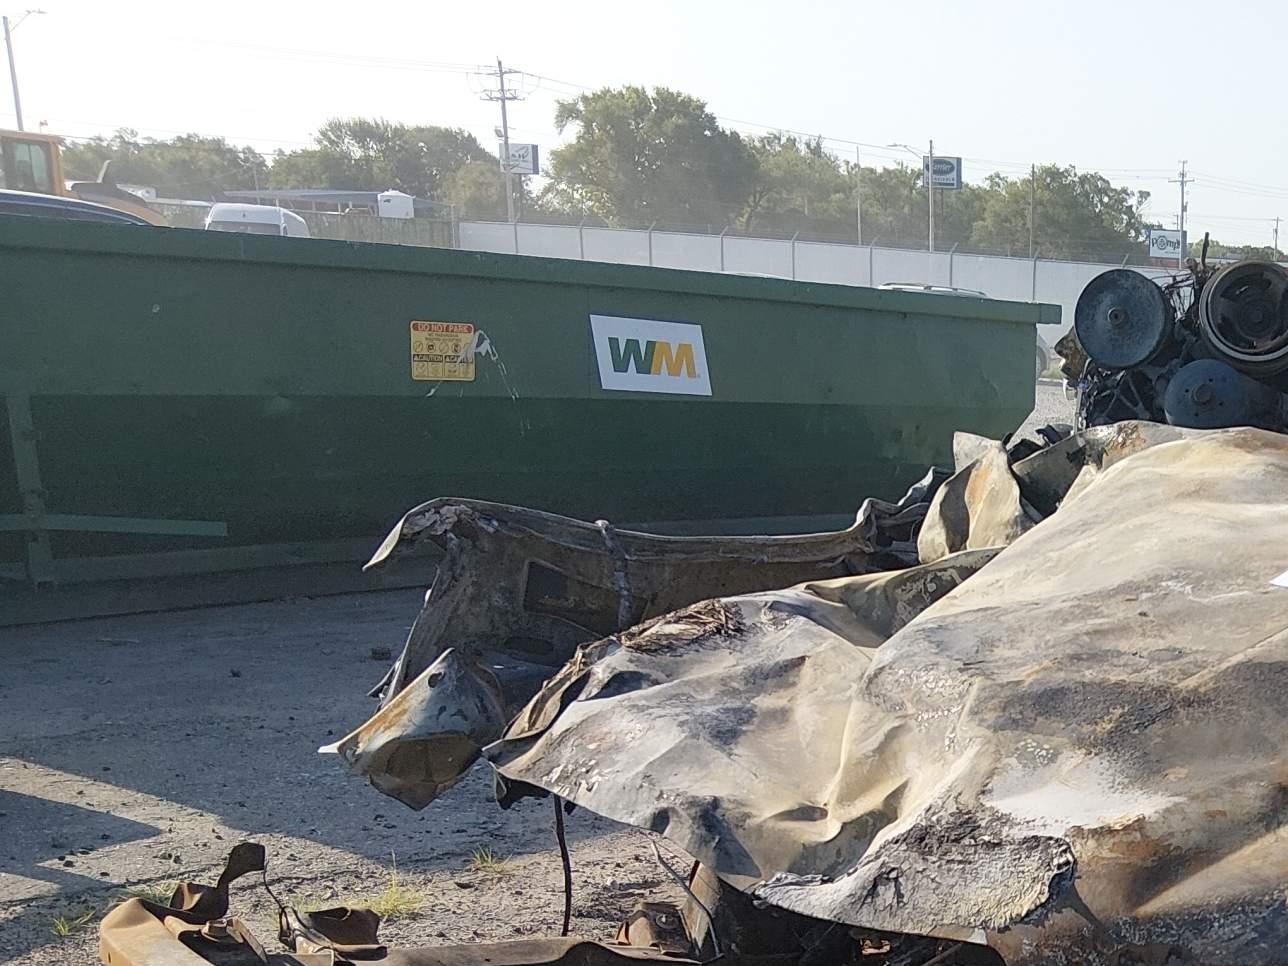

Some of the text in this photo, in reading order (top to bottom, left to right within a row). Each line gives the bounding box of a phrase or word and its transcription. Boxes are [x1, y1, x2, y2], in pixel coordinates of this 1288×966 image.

[418, 323, 469, 333] DO NOT PARK
[608, 336, 697, 379] WM
